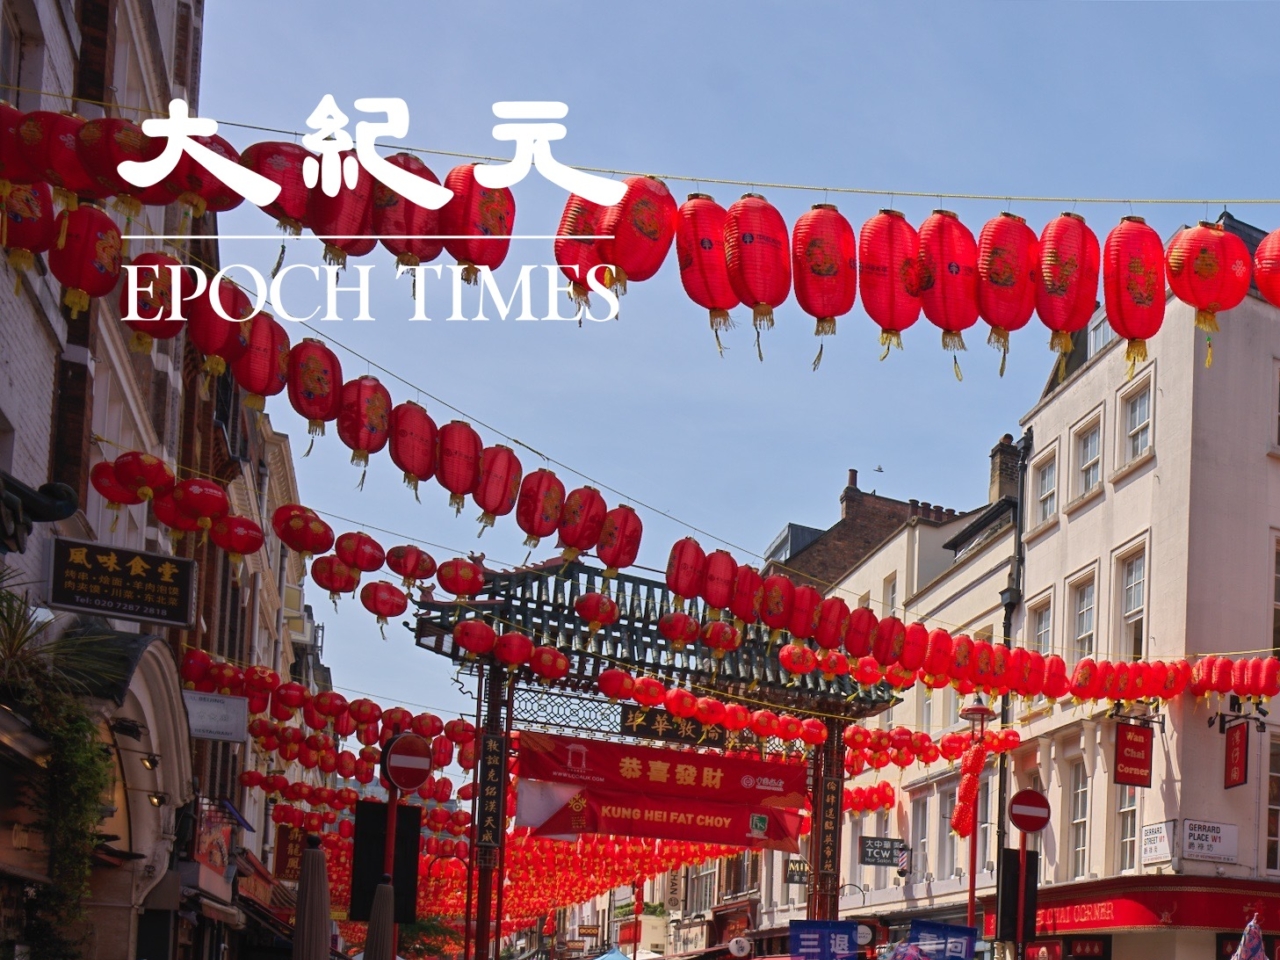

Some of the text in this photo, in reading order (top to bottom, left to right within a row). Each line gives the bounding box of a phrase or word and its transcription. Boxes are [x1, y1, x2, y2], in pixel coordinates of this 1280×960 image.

[68, 547, 179, 583] 風味食堂
[74, 595, 167, 616] Tel: 020 7287 2818
[1126, 731, 1144, 743] Wan
[1124, 748, 1145, 759] Chai
[619, 757, 724, 789] 恭喜發財
[1117, 763, 1149, 776] Corner
[601, 805, 732, 829] KUNG HEI FAT CHOY
[1189, 823, 1221, 834] GERRARD
[1144, 836, 1158, 846] STREET
[1189, 833, 1221, 843] PLACE W1
[866, 849, 890, 858] TCW
[1046, 905, 1070, 924] CHAI
[1073, 902, 1114, 923] CORNER
